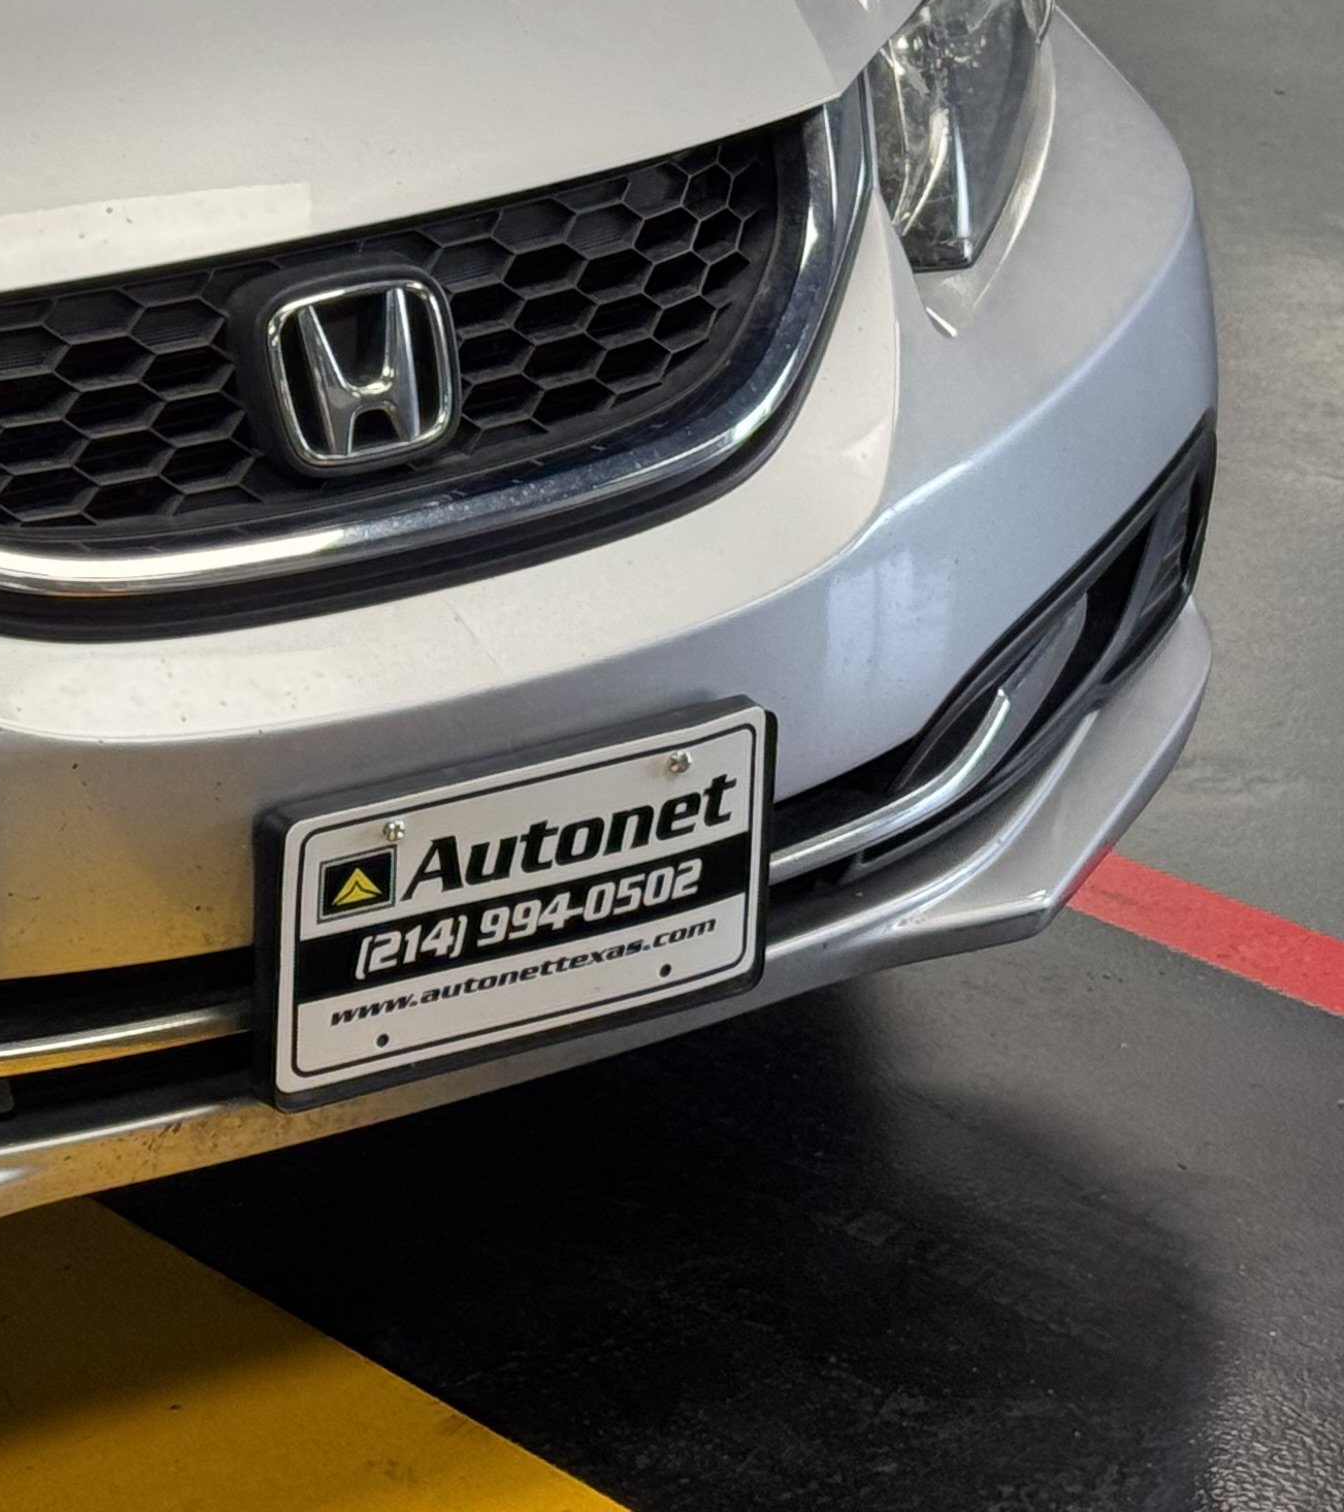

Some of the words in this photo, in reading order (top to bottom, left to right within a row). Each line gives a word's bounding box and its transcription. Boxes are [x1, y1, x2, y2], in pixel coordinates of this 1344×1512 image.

[399, 773, 738, 902] Autonet
[330, 917, 717, 1027] www.autonettexas.com
[355, 915, 468, 981] (214)
[477, 857, 703, 948] 994-0502
